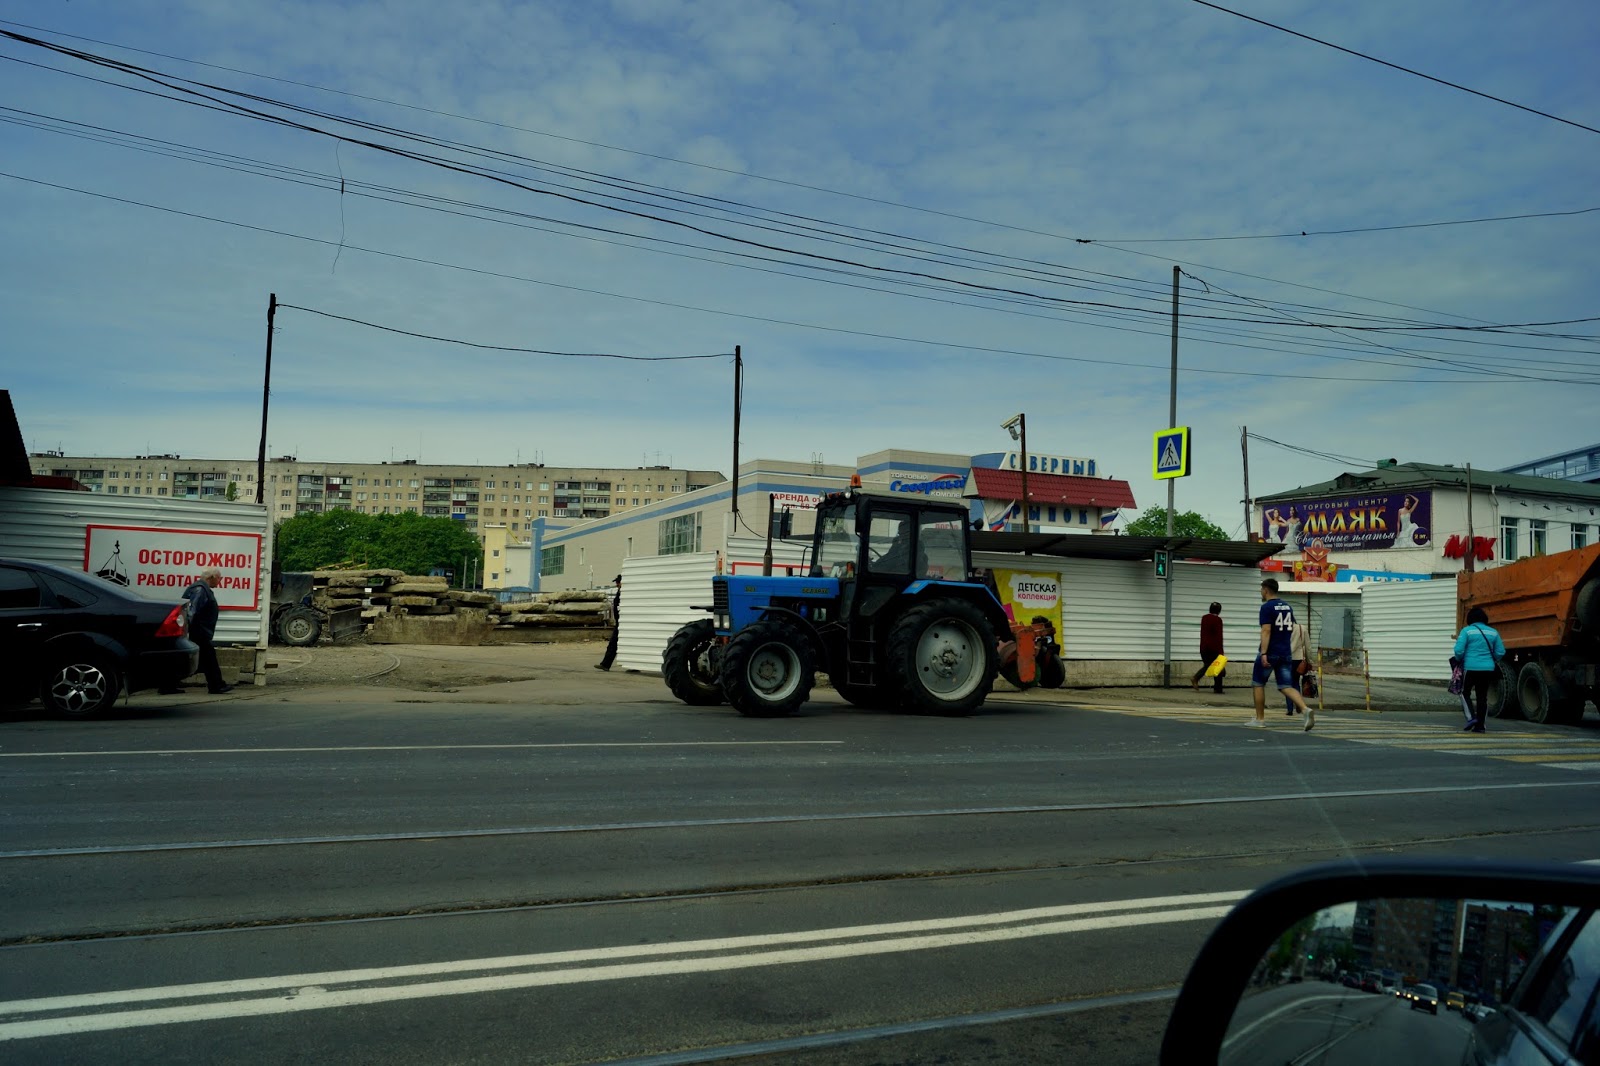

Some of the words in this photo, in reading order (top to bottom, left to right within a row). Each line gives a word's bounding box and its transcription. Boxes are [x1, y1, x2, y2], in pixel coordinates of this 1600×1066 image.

[1303, 502, 1349, 511] ТОРГОВЫЙ
[1358, 498, 1388, 507] ЦЕНТР
[1302, 506, 1388, 535] МАЯК
[1294, 531, 1350, 545] Свебные
[138, 549, 252, 569] ОСТОРОЖНО!
[137, 573, 201, 587] РАБОТАЕ
[1017, 582, 1057, 593] ДЕТСКАЯ
[1274, 611, 1294, 633] 44
